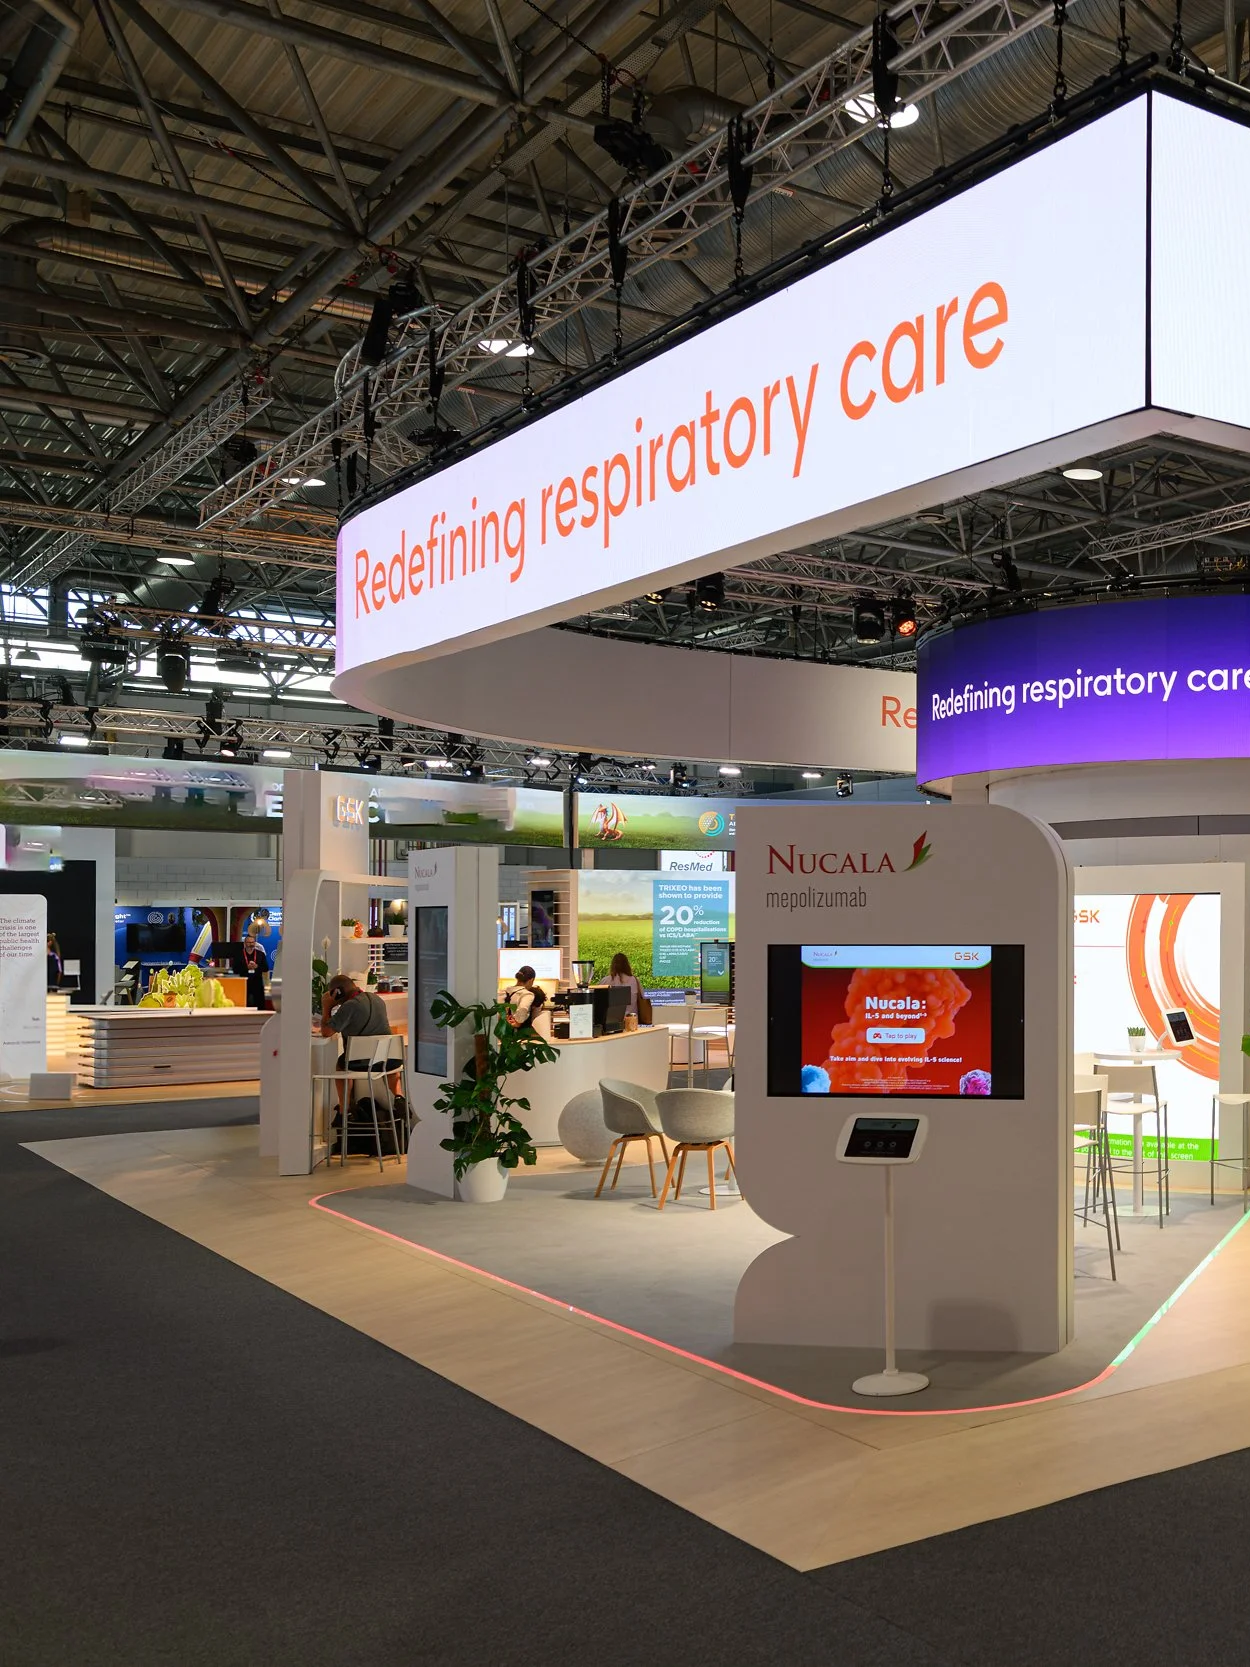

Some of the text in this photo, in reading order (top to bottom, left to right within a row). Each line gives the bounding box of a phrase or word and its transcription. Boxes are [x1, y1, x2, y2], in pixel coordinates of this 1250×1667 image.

[354, 281, 1009, 619] Redefining respiratory care
[931, 680, 1016, 721] Redefining
[1021, 668, 1177, 709] respiratory
[336, 795, 365, 825] GSK
[669, 861, 713, 872] ResMed
[767, 844, 896, 875] NUCALA
[658, 884, 688, 892] TRIXEO
[693, 892, 723, 900] provide
[766, 886, 867, 912] mepolizumab
[954, 951, 979, 961] GSK
[865, 996, 927, 1010] Nucala:
[1187, 1142, 1199, 1150] the
